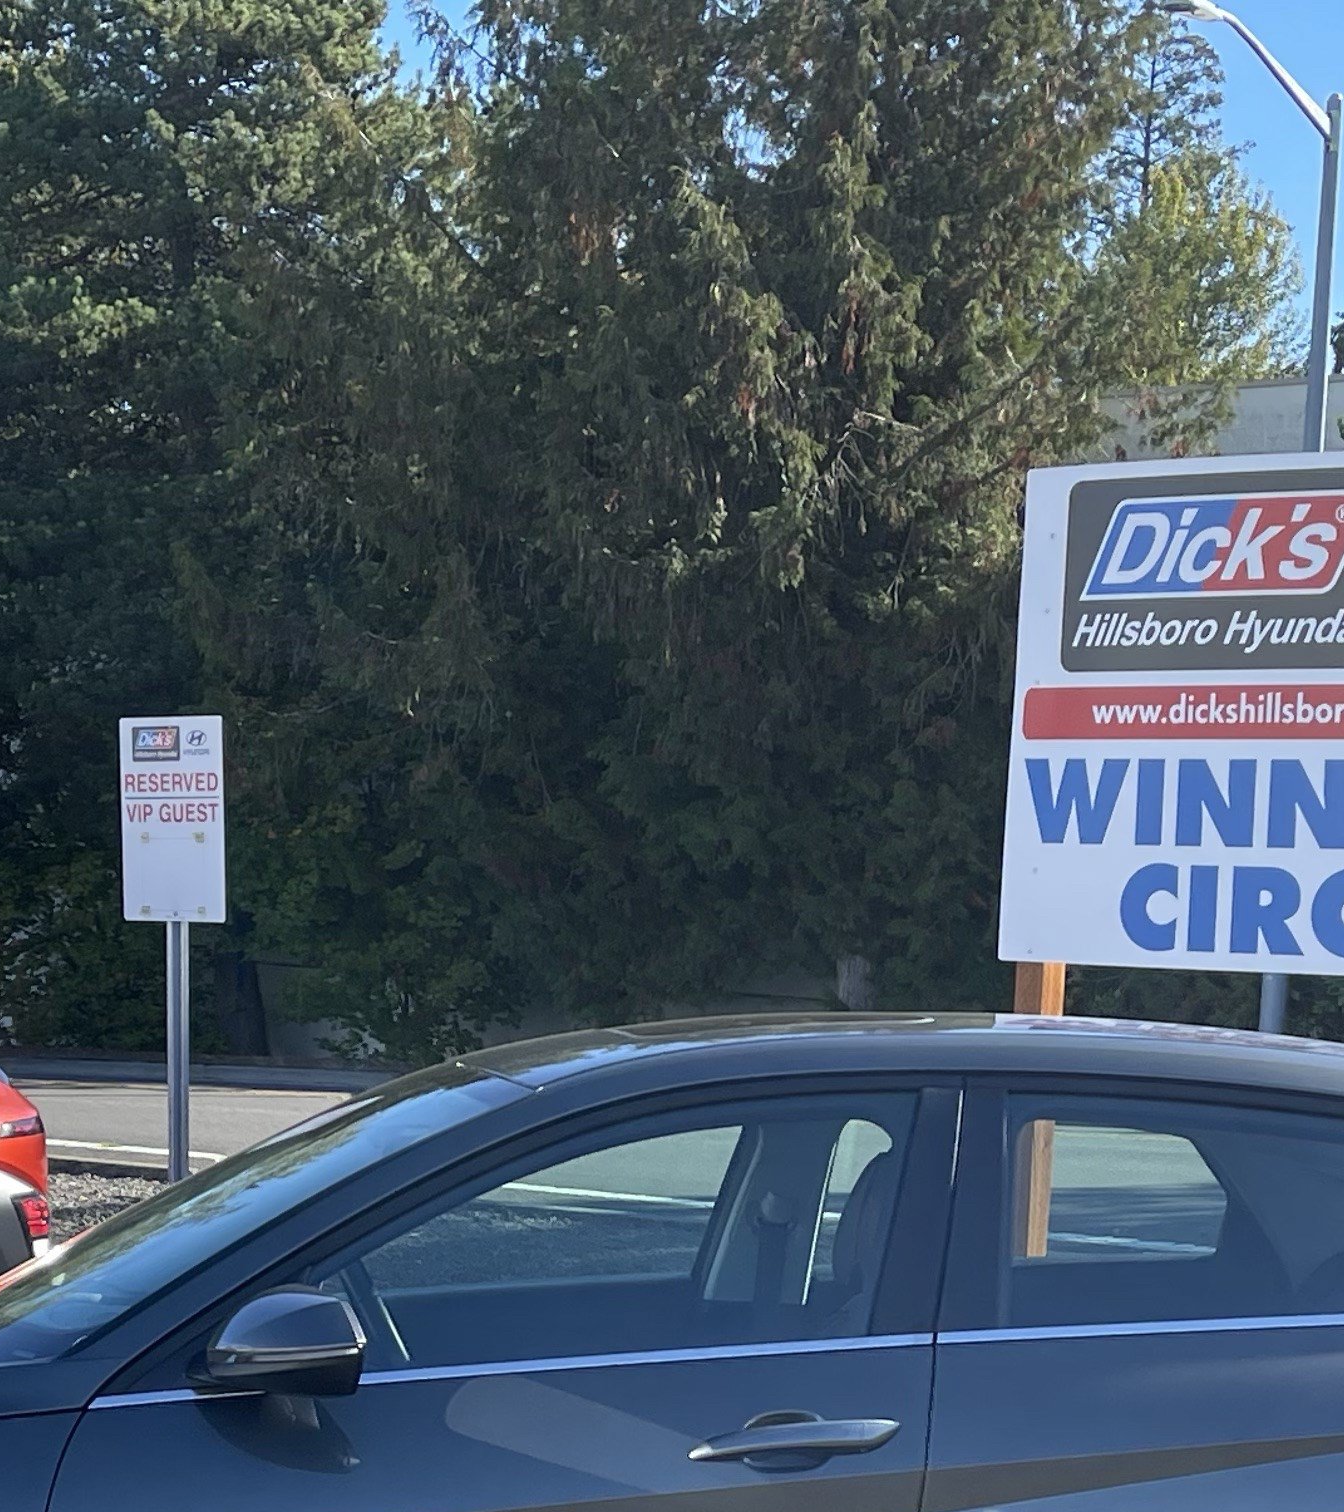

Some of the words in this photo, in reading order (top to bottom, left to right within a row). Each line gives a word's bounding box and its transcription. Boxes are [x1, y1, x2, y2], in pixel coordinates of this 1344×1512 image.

[1101, 503, 1338, 585] Dick's
[1071, 612, 1218, 647] Hillsboro
[124, 772, 219, 792] RESERVED
[126, 803, 153, 823] VIP
[159, 803, 219, 823] GUEST
